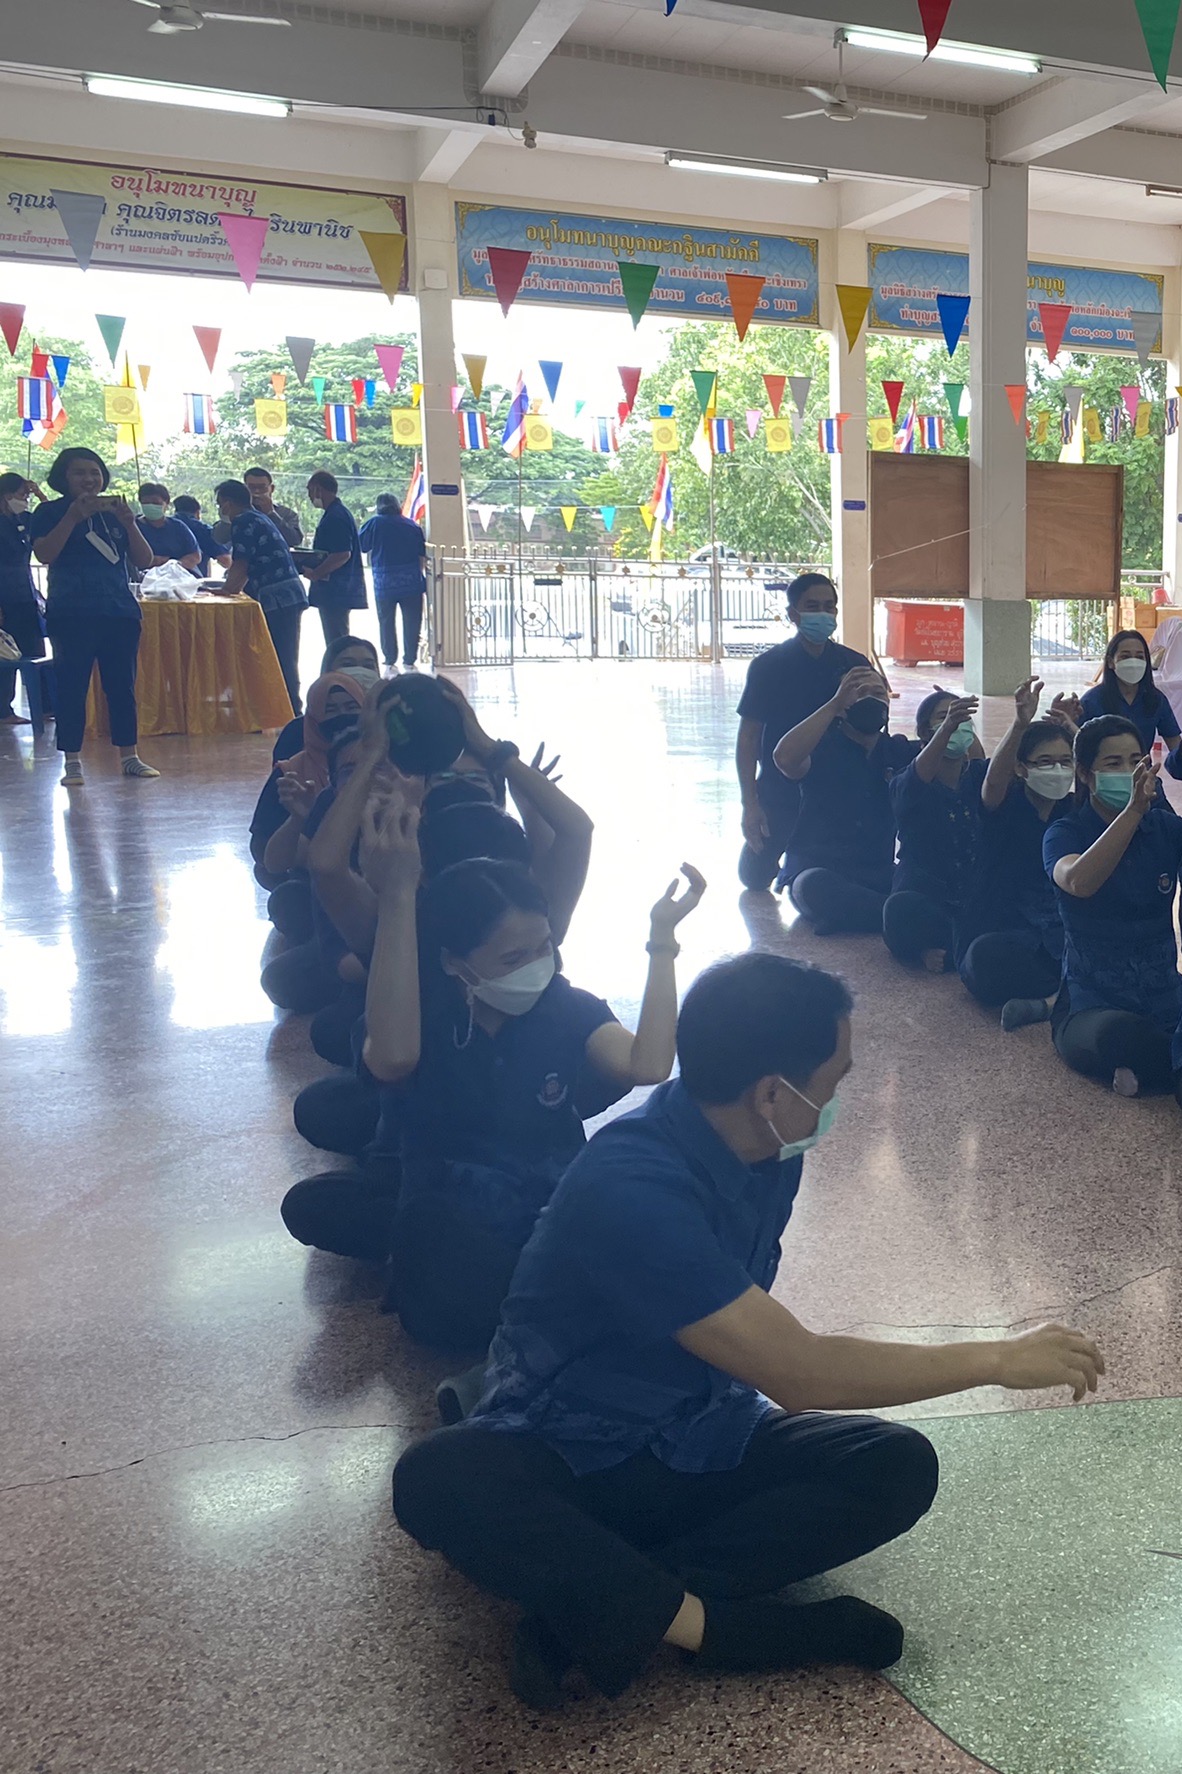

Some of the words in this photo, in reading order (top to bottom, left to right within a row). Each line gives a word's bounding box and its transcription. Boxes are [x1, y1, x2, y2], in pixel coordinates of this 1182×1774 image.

[110, 168, 258, 208] อนุโมทนาบุญ
[526, 219, 760, 262] อนุโมทนาบุญคณะกฐินสามัคคี
[774, 299, 797, 312] บาท
[1071, 326, 1113, 339] ๑๐๐,๐๐๐
